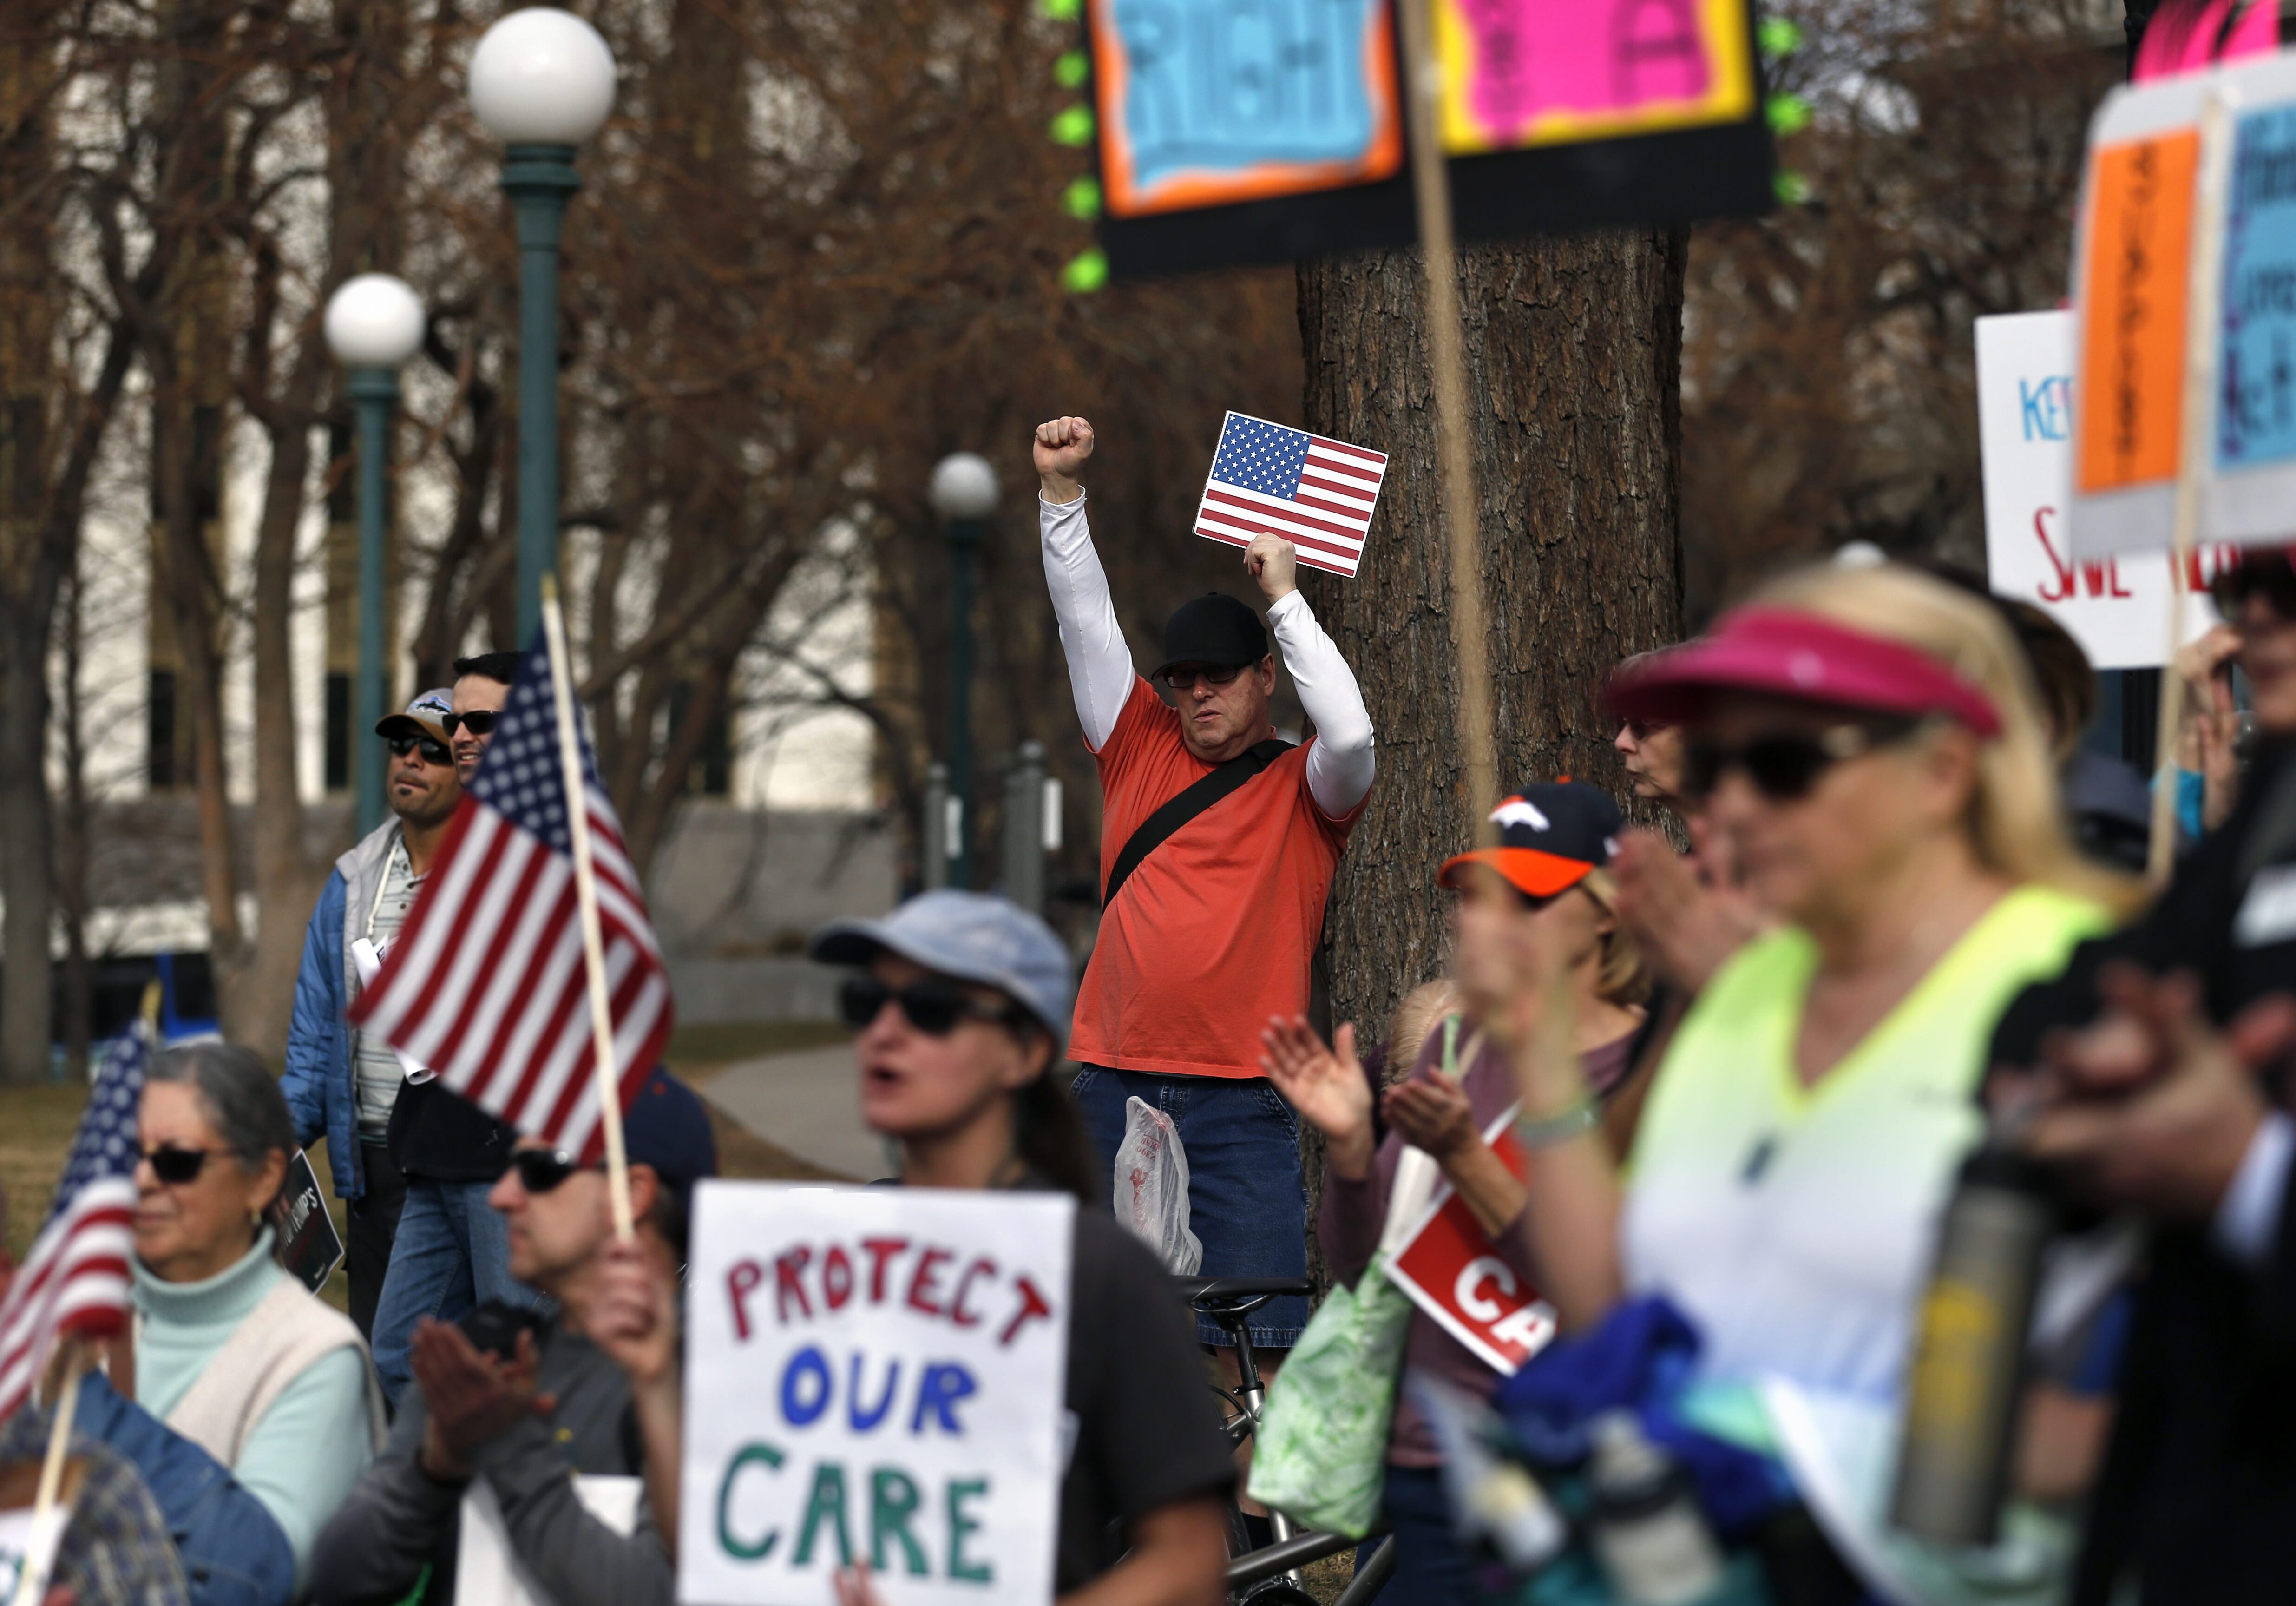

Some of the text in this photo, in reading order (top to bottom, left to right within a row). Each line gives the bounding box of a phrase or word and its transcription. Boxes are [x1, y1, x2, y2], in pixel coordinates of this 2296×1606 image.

[726, 1235, 1054, 1349] PROTECT
[779, 1342, 979, 1437] OUR
[716, 1439, 995, 1585] CARE
